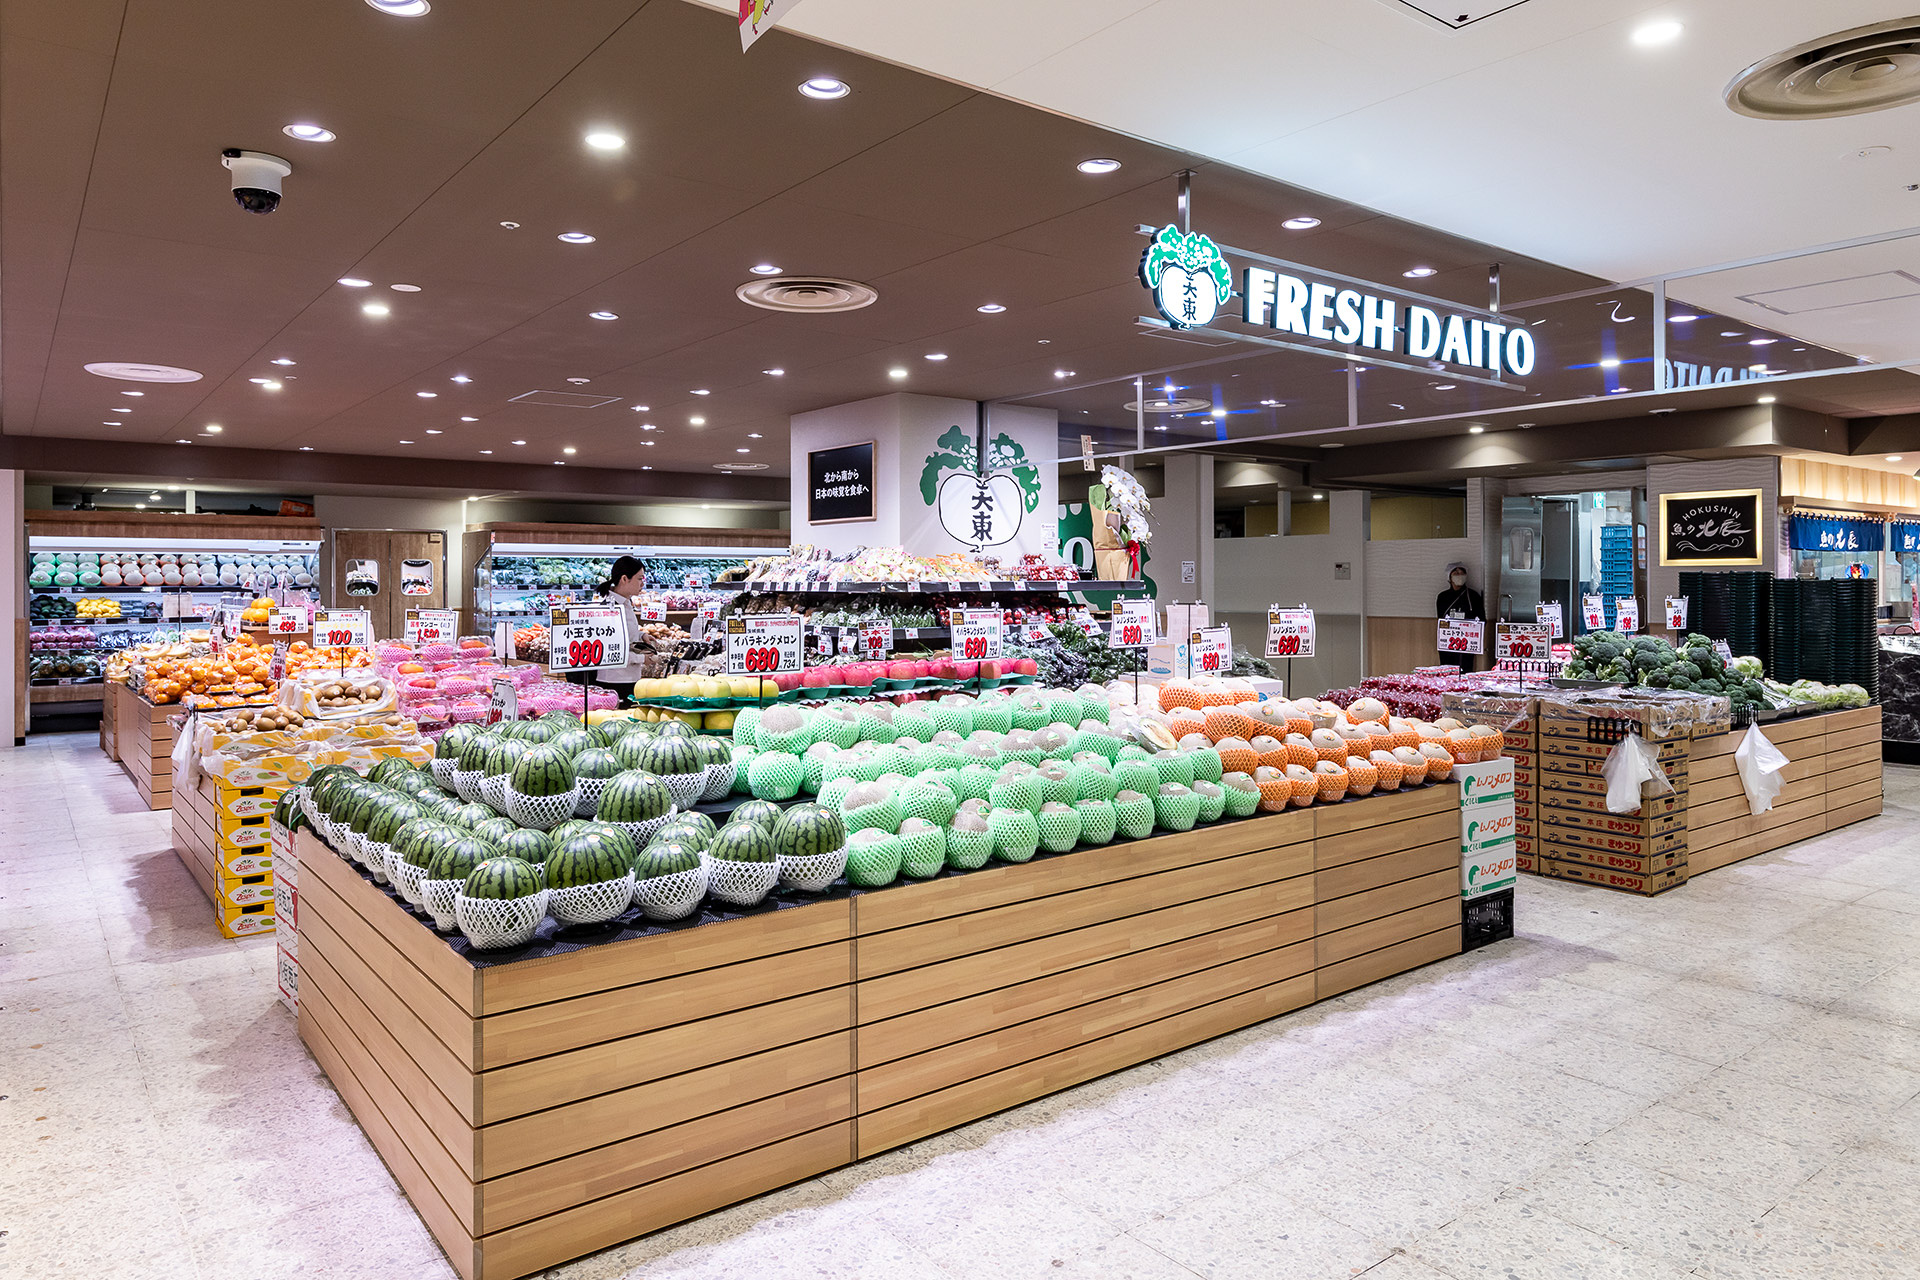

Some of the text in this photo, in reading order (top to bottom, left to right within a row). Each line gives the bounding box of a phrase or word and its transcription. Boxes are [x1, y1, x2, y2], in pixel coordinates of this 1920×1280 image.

[1182, 281, 1198, 321] 大東
[1248, 266, 1536, 377] FRESH DAITO
[824, 468, 860, 483] 北から南から
[815, 483, 870, 500] 日本の味覚を食卓へ
[970, 491, 994, 542] 大東
[1682, 505, 1741, 521] HOKUSHIN
[279, 620, 297, 633] 498
[563, 625, 616, 639] 小玉すいか
[1122, 624, 1142, 645] 680
[327, 629, 352, 646] 100
[734, 634, 797, 647] イバラキングメロン
[1278, 634, 1300, 656] 680
[1447, 636, 1468, 651] 298
[1500, 634, 1548, 643] 3本で
[568, 638, 604, 668] 980
[964, 636, 988, 659] 680
[1508, 641, 1533, 658] 100
[745, 646, 780, 673] 680
[783, 659, 796, 669] 734
[1202, 651, 1220, 671] 680
[1476, 772, 1512, 789] レノンメロン
[1479, 815, 1513, 834] レノンメロン
[1607, 819, 1641, 836] きゅうり
[1608, 838, 1641, 854] きゅうり
[1480, 857, 1514, 877] レノンメロン
[1608, 856, 1642, 872] きゅうり
[1609, 875, 1643, 891] きゅうり
